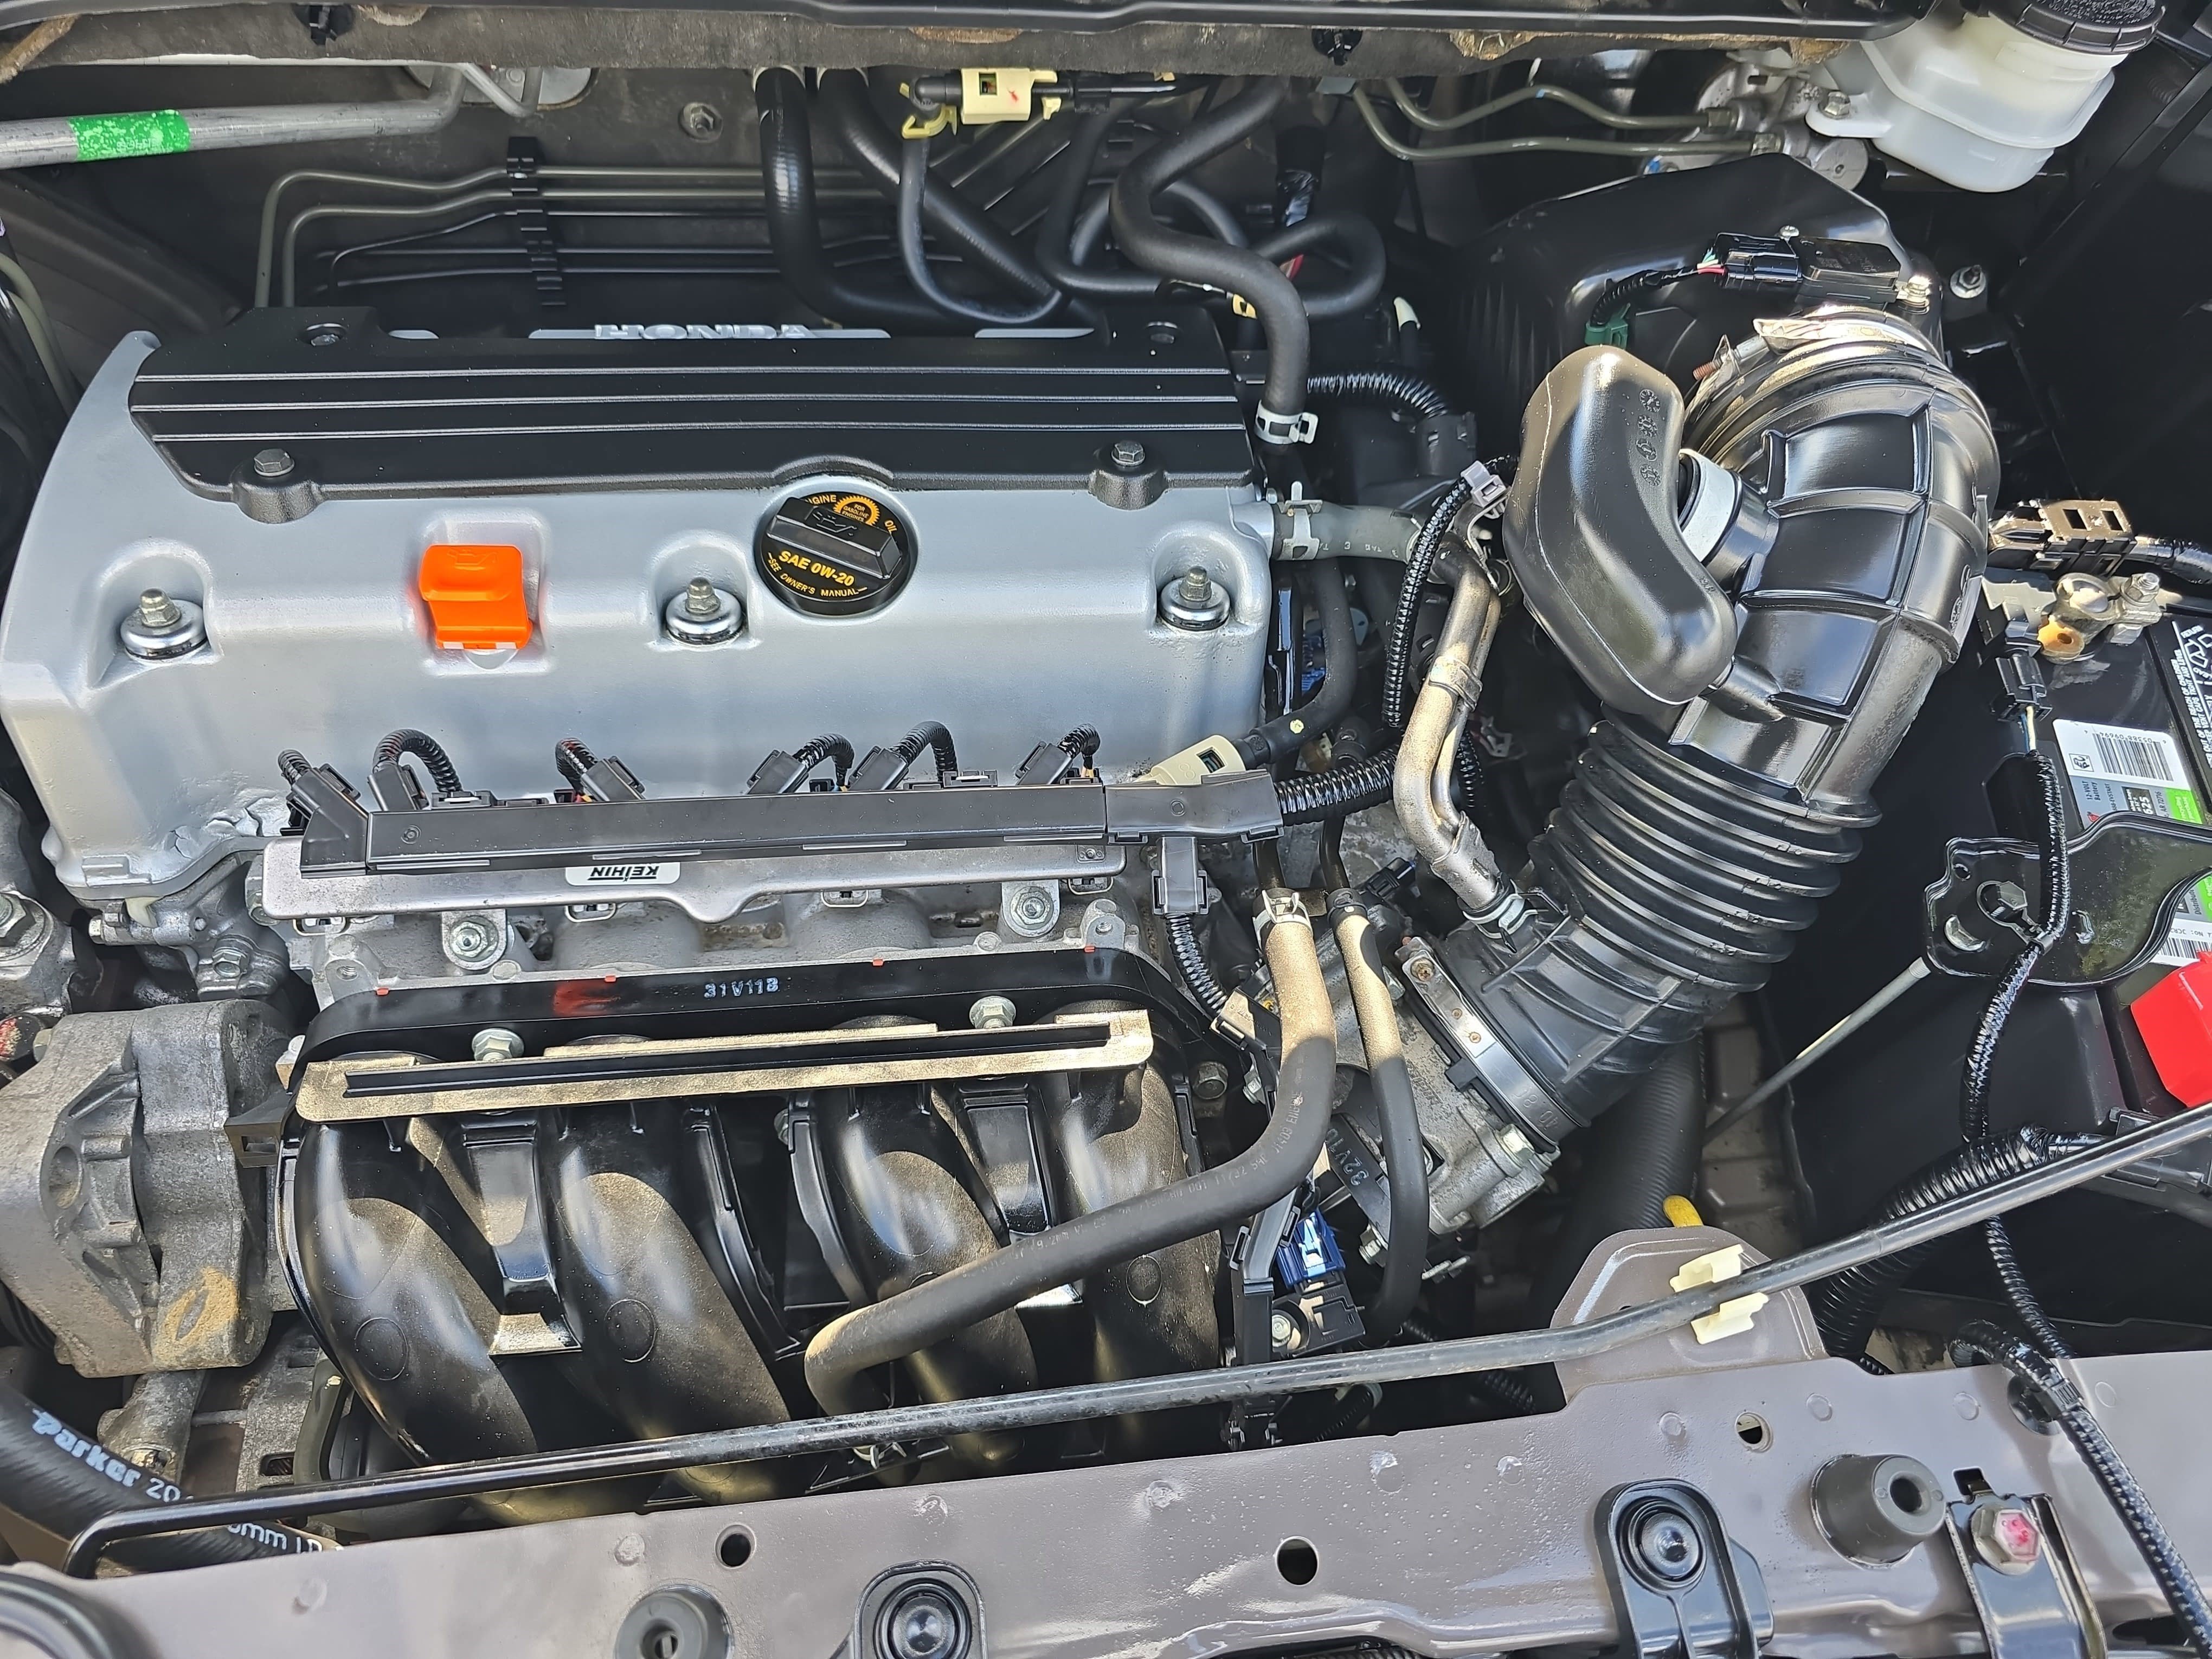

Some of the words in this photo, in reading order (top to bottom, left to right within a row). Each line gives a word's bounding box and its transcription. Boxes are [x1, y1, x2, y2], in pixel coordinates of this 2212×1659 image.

[595, 324, 816, 339] HONDA
[805, 494, 837, 505] NGINE
[884, 519, 898, 534] OIL
[843, 505, 870, 519] GASOLINE
[854, 503, 866, 512] FOR
[779, 550, 812, 570] SAE
[811, 561, 855, 587] 0W-20
[780, 573, 816, 595] OWNER'S
[2170, 658, 2187, 686] CHILDREN
[2180, 666, 2191, 679] AND
[2181, 687, 2191, 696] OF
[2184, 679, 2197, 695] TIGHT
[2184, 696, 2198, 716] REACH
[2191, 697, 2204, 713] CAPS
[2191, 716, 2202, 729] THE
[2197, 713, 2210, 729] VENT
[2099, 731, 2124, 740] 09694
[2082, 780, 2093, 800] 12-VOLT
[2091, 781, 2101, 801] Battery
[2139, 796, 2153, 815] 625
[589, 866, 660, 882] KEIHIN
[31, 1409, 142, 1488] Parker
